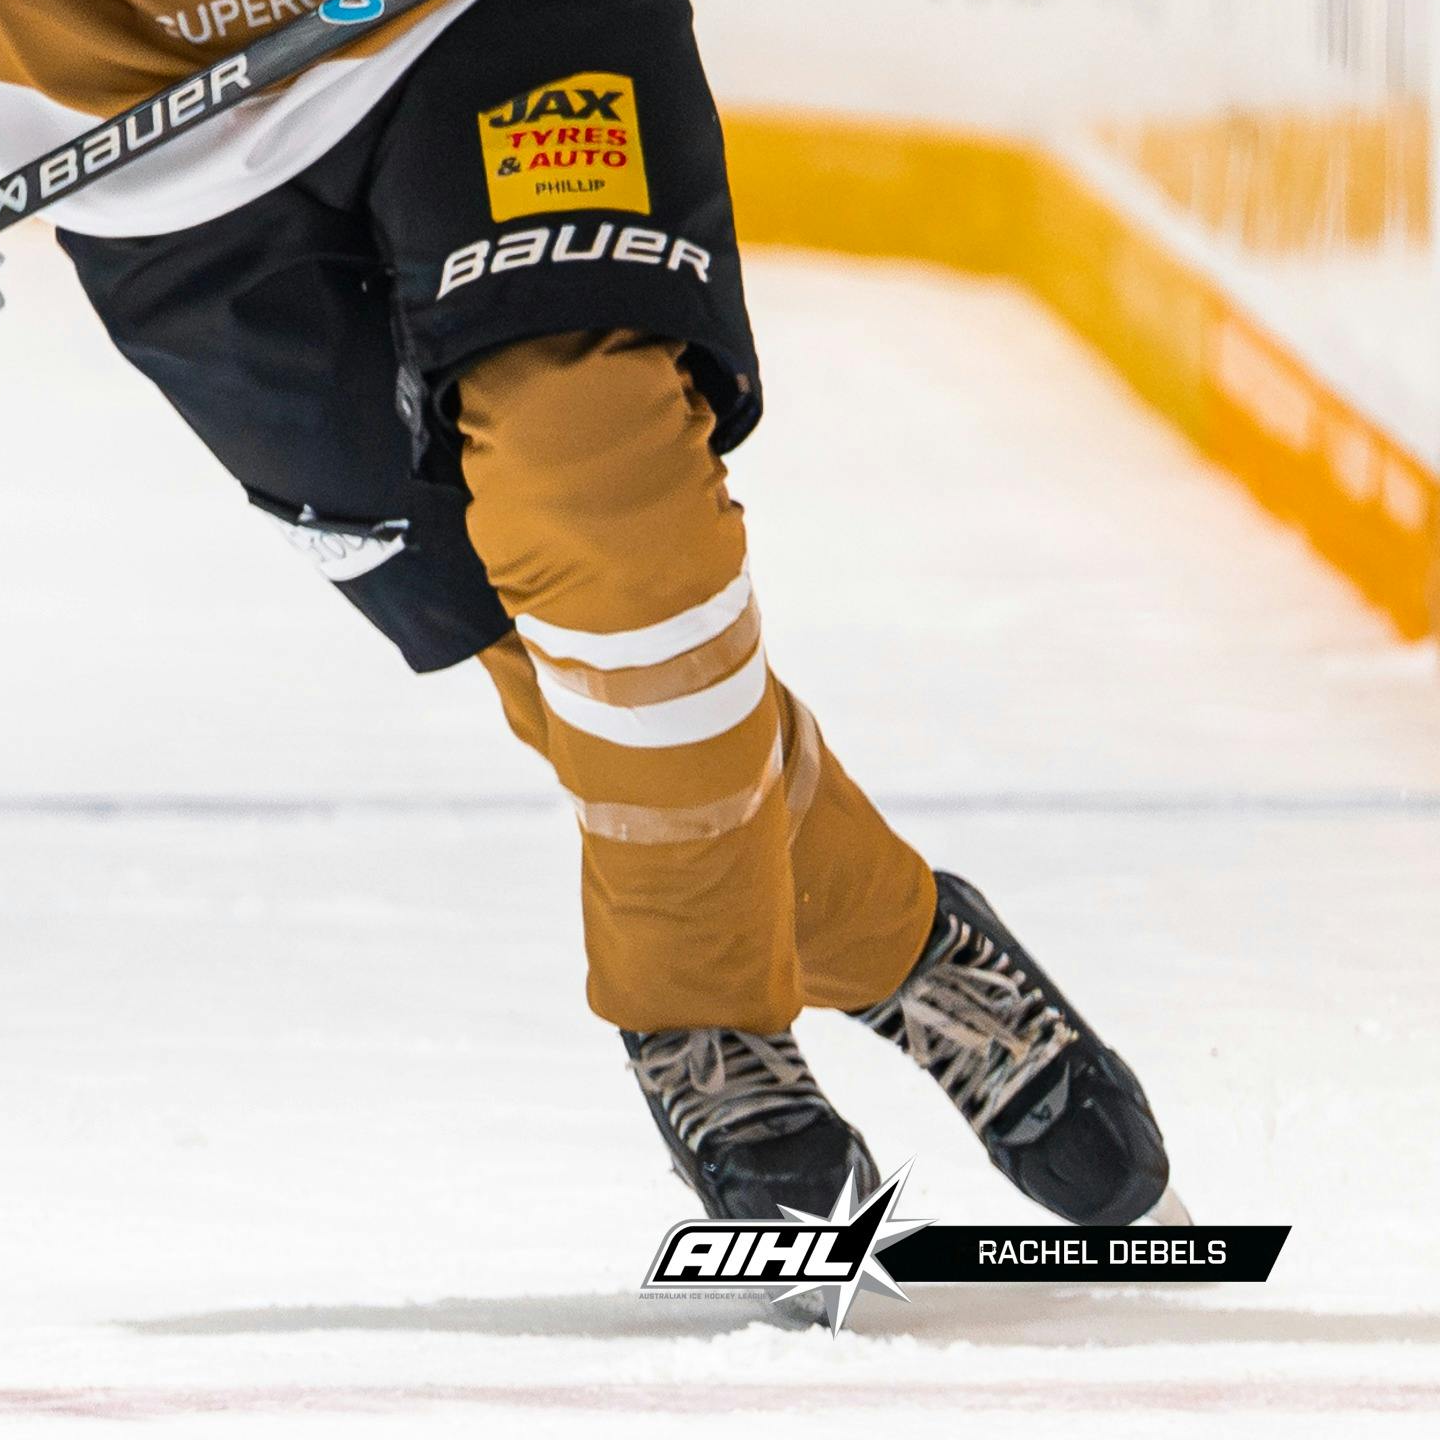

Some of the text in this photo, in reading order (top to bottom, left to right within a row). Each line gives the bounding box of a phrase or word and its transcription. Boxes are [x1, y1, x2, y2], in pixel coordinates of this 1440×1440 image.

[488, 89, 624, 128] JAX
[39, 53, 253, 201] BAUER
[508, 126, 628, 148] TYRES
[497, 149, 628, 176] & AUTO
[535, 180, 606, 195] PHILLIP
[436, 223, 712, 301] BAUER
